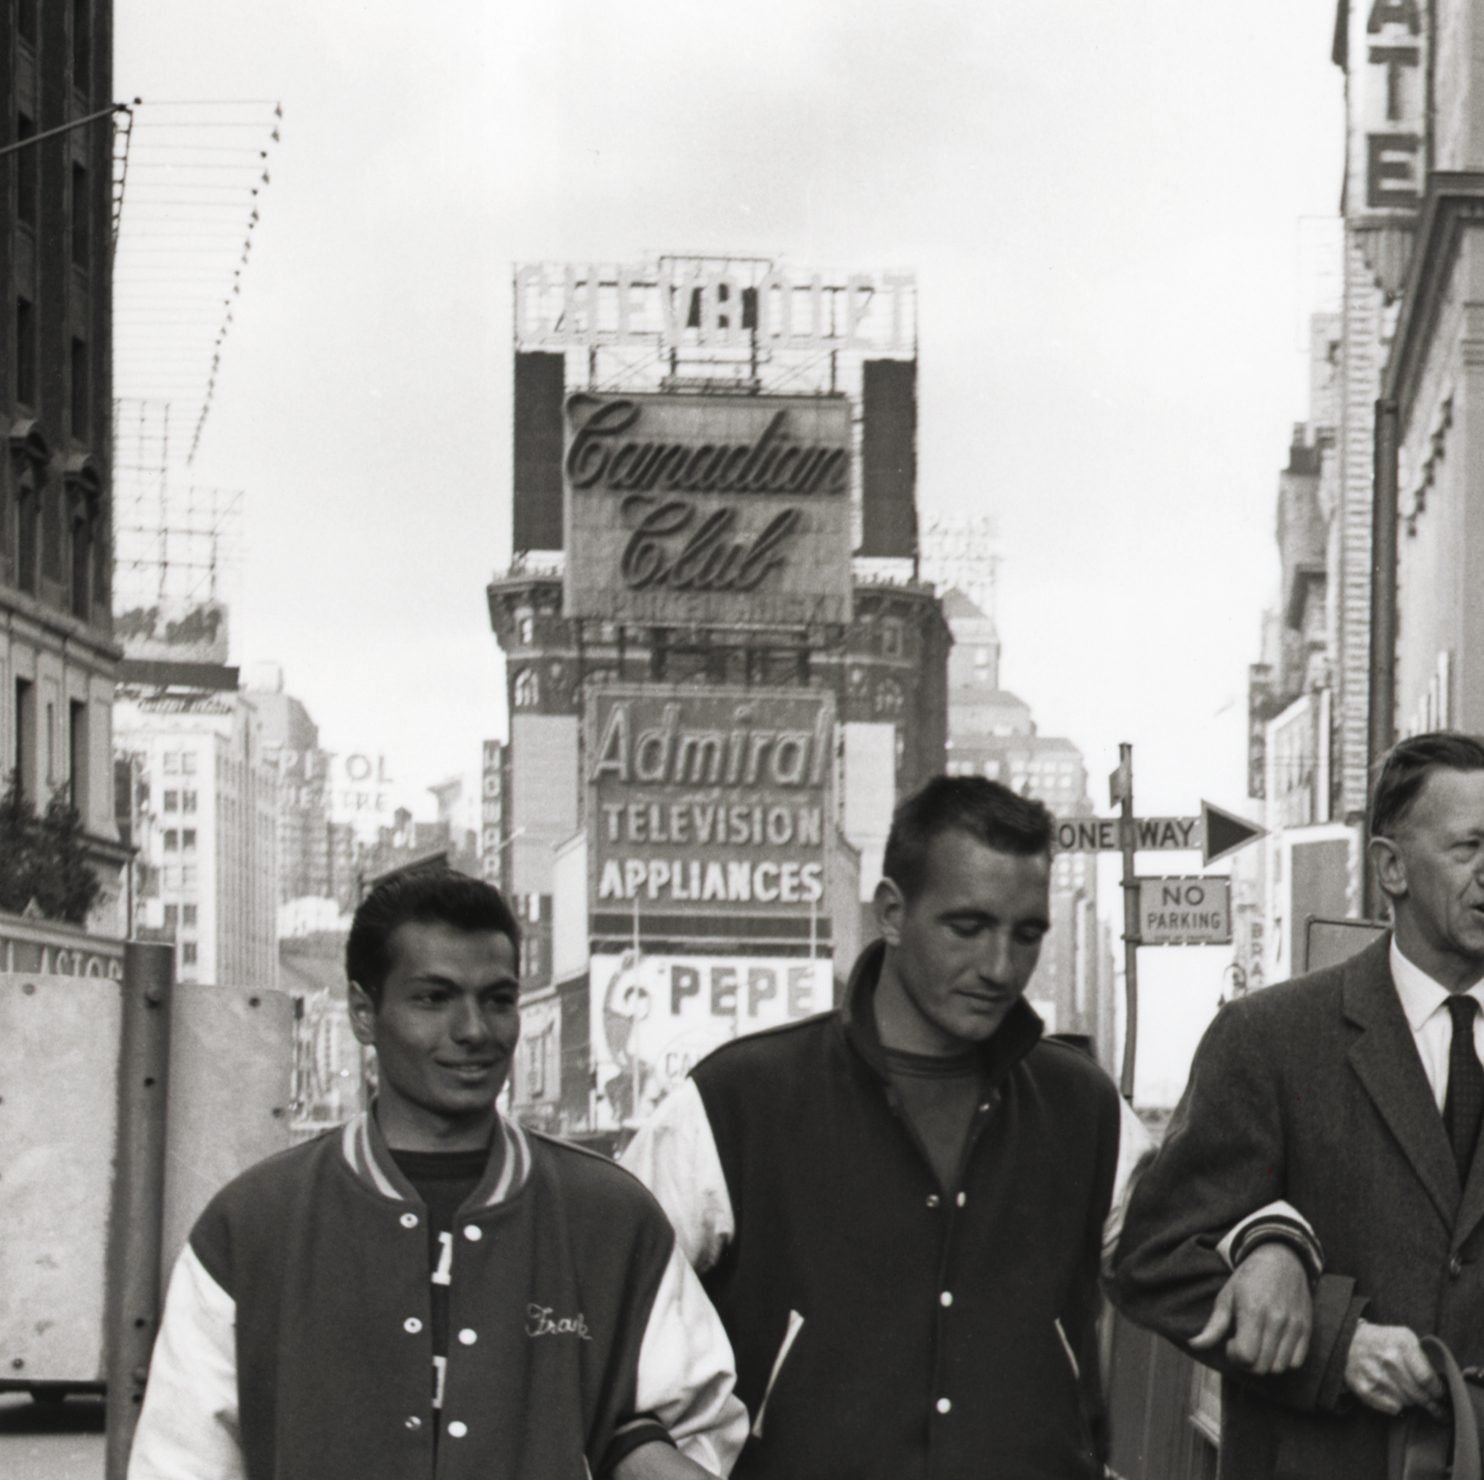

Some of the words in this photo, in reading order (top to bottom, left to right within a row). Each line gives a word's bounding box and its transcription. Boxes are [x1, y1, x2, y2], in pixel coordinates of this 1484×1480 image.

[566, 393, 848, 494] Canadian
[620, 494, 801, 592] Club
[588, 702, 835, 786] Admiral
[602, 803, 821, 845] TELEVISION
[1057, 822, 1114, 849] ONE
[1137, 821, 1195, 848] WAY
[599, 859, 823, 903] APPLIANCES
[1161, 885, 1206, 907] NO
[1147, 911, 1221, 932] PARKING
[524, 1302, 594, 1340] Frak
